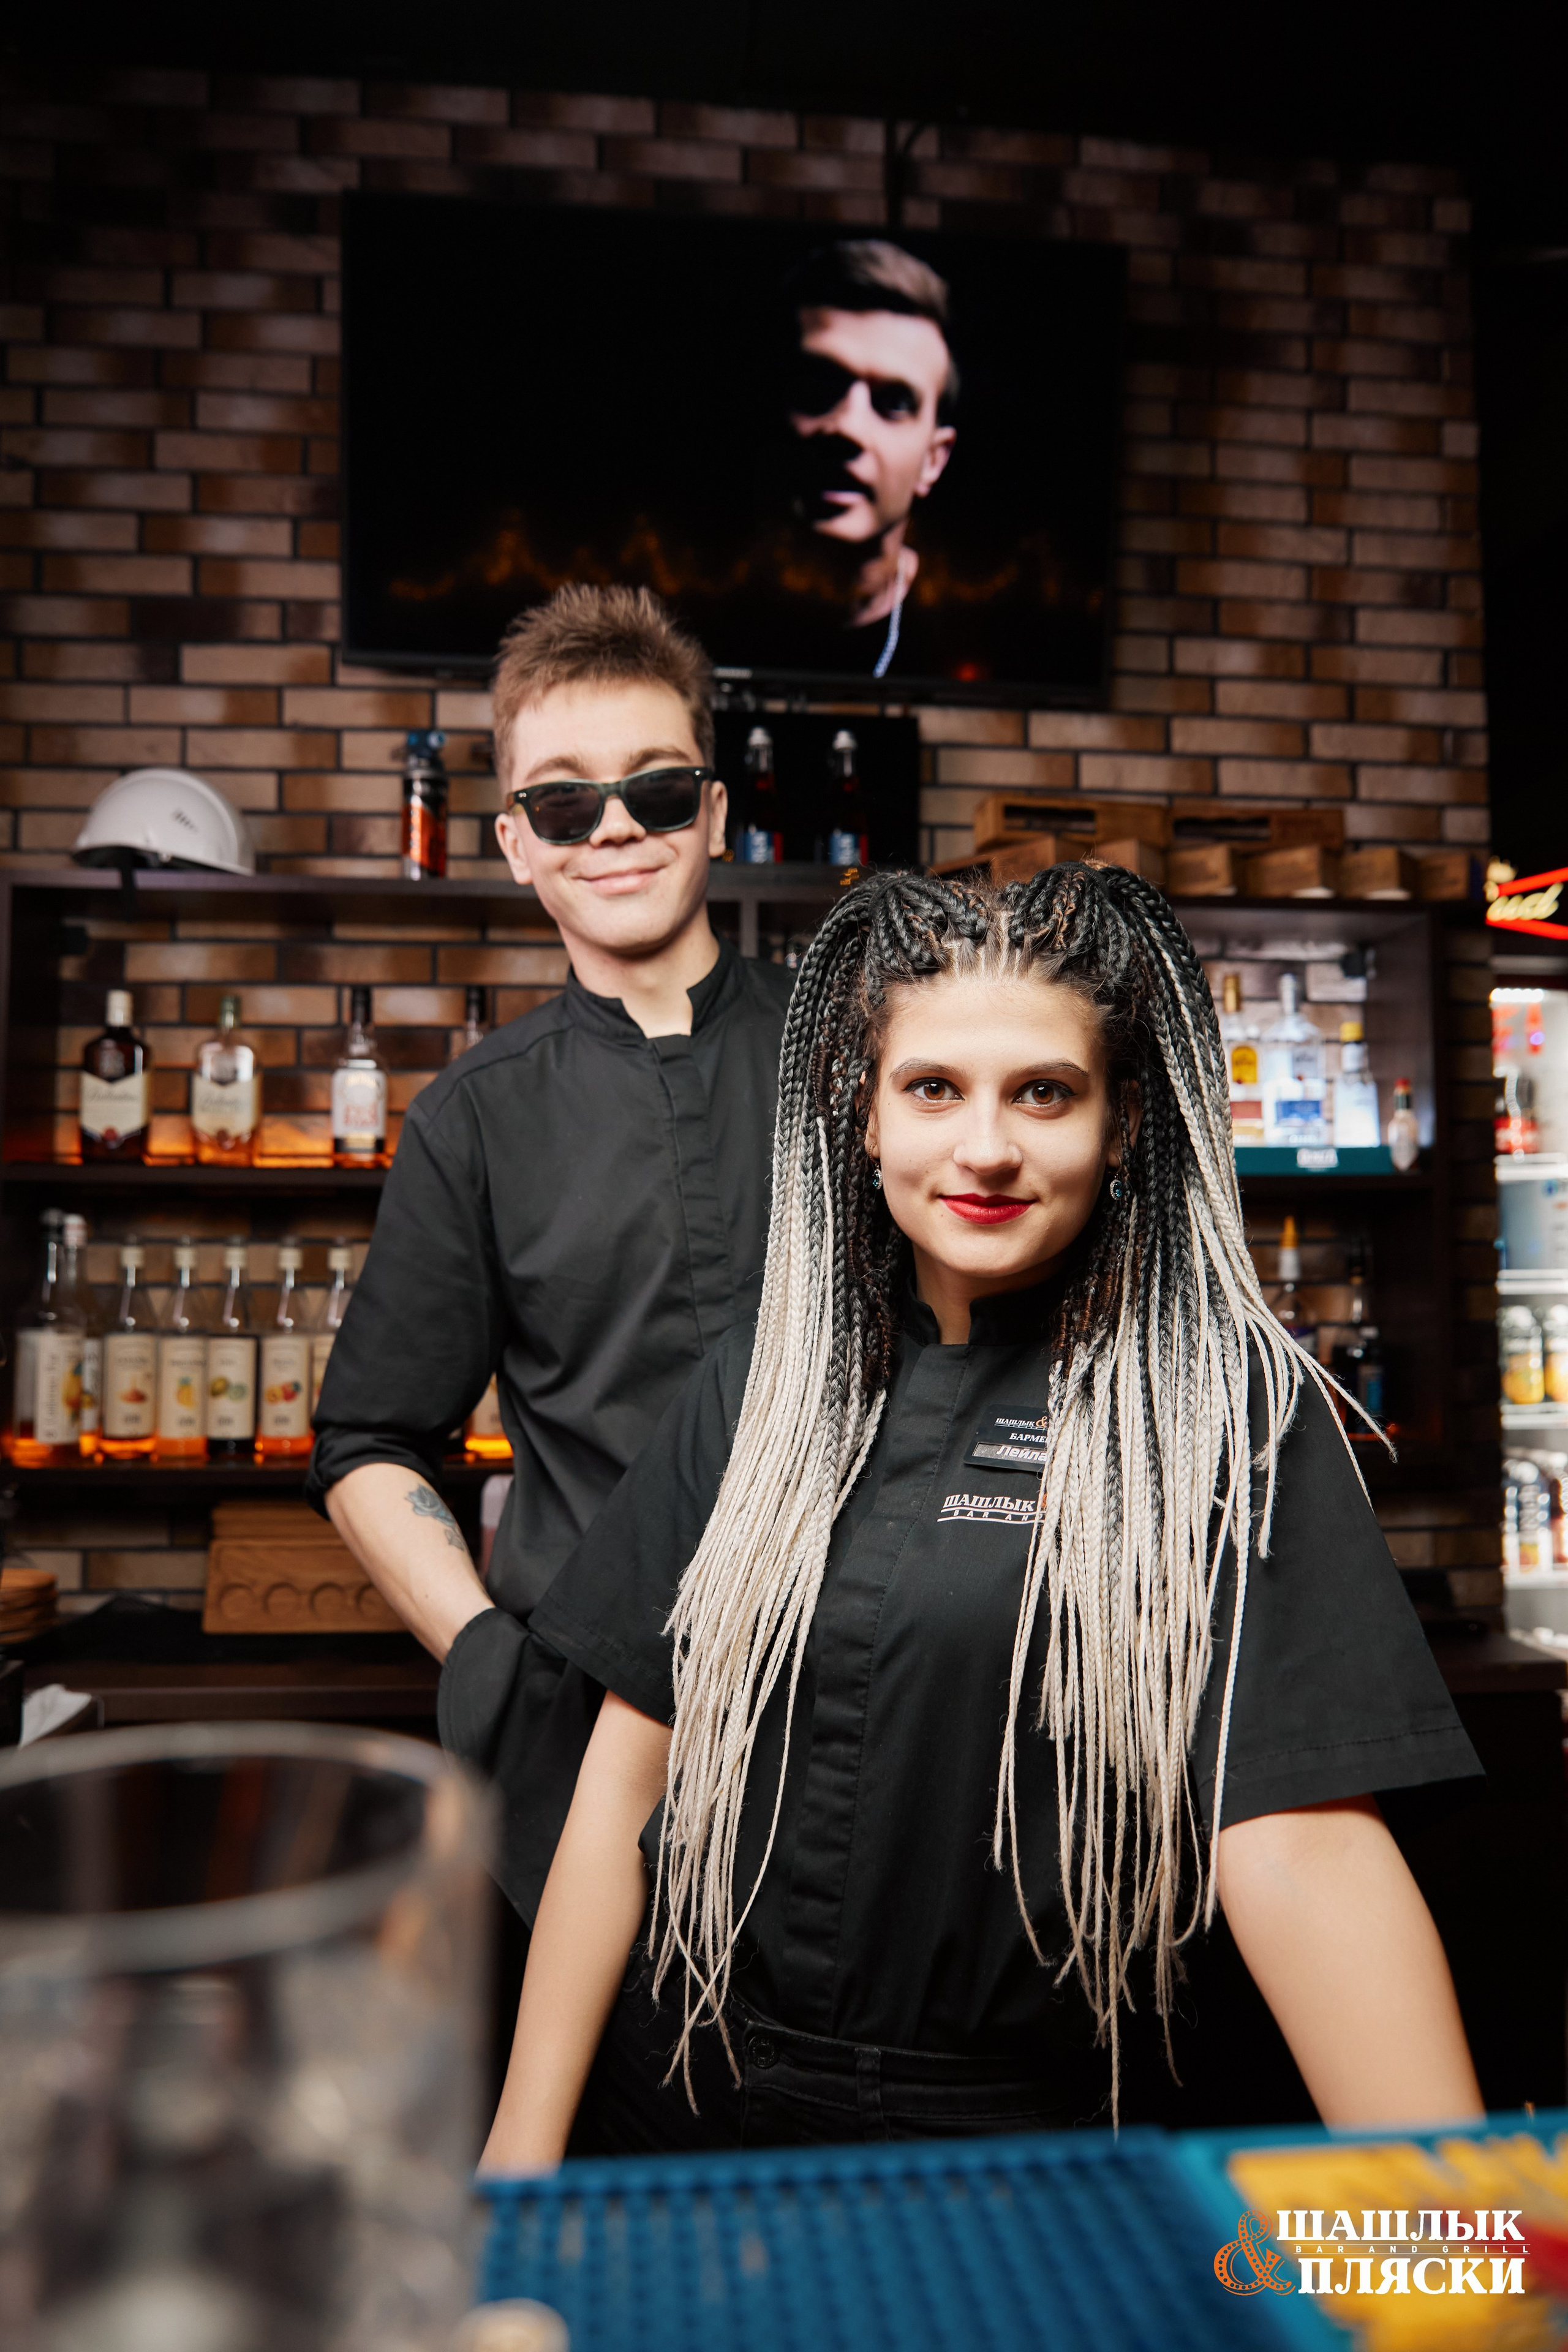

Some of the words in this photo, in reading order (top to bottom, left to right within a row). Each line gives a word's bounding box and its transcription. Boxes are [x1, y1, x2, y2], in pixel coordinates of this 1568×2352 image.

[995, 1417, 1035, 1427] ШАШЛЫК
[996, 1446, 1047, 1462] Лейла
[943, 1494, 1036, 1512] ШАШЛЫК
